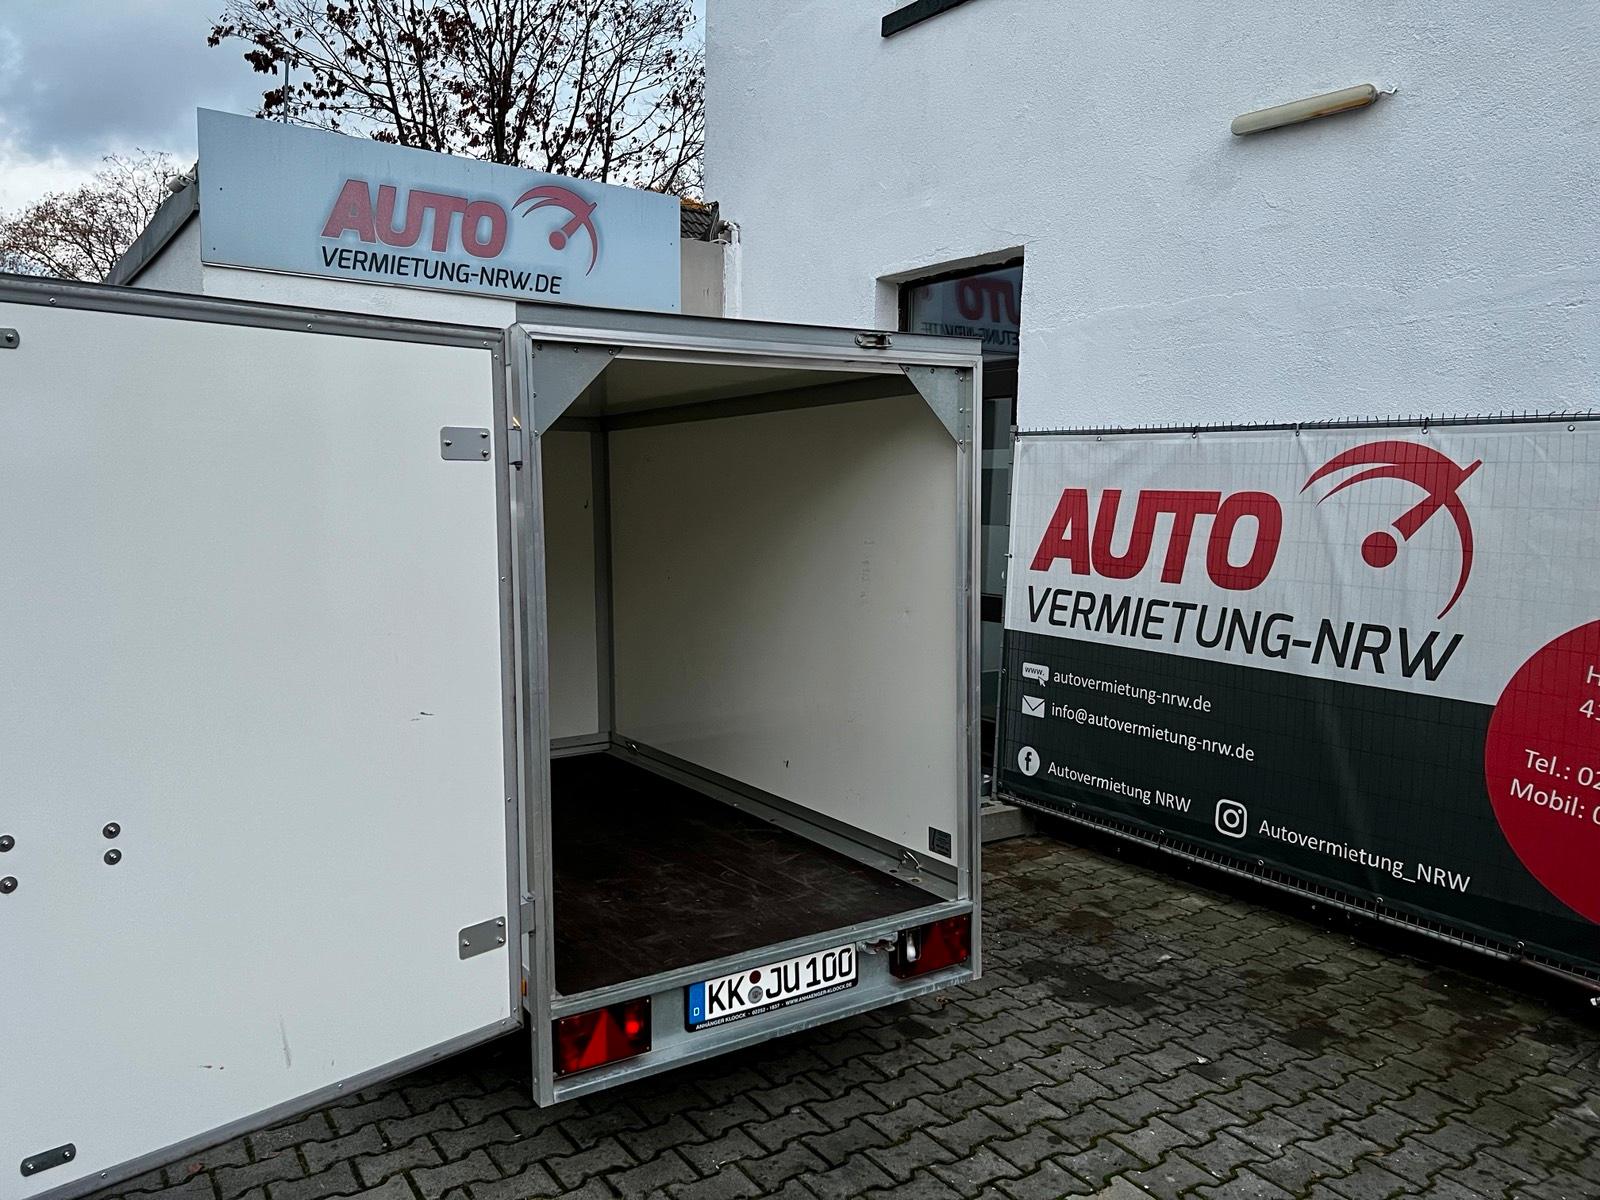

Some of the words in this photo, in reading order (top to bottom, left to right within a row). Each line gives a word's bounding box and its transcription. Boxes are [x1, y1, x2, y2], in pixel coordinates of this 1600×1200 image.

[320, 178, 508, 259] AUTO
[320, 246, 562, 295] VERMIETUNG-NRW.DE
[1030, 488, 1283, 591] AUTO
[1027, 585, 1464, 682] VERMIETUNG-NRW
[1053, 670, 1211, 713] autovermietung-nrw.de
[1051, 702, 1255, 762] info@autovermietung-nrw.de
[1048, 761, 1151, 805] Autovermietung
[1155, 790, 1191, 813] NRW
[1525, 748, 1570, 780] Tel.:
[1510, 778, 1585, 819] Mobil:
[1258, 819, 1470, 893] Autovermietung_NRW
[708, 975, 745, 1015] KK
[765, 962, 800, 998] JU
[806, 948, 852, 988] 100
